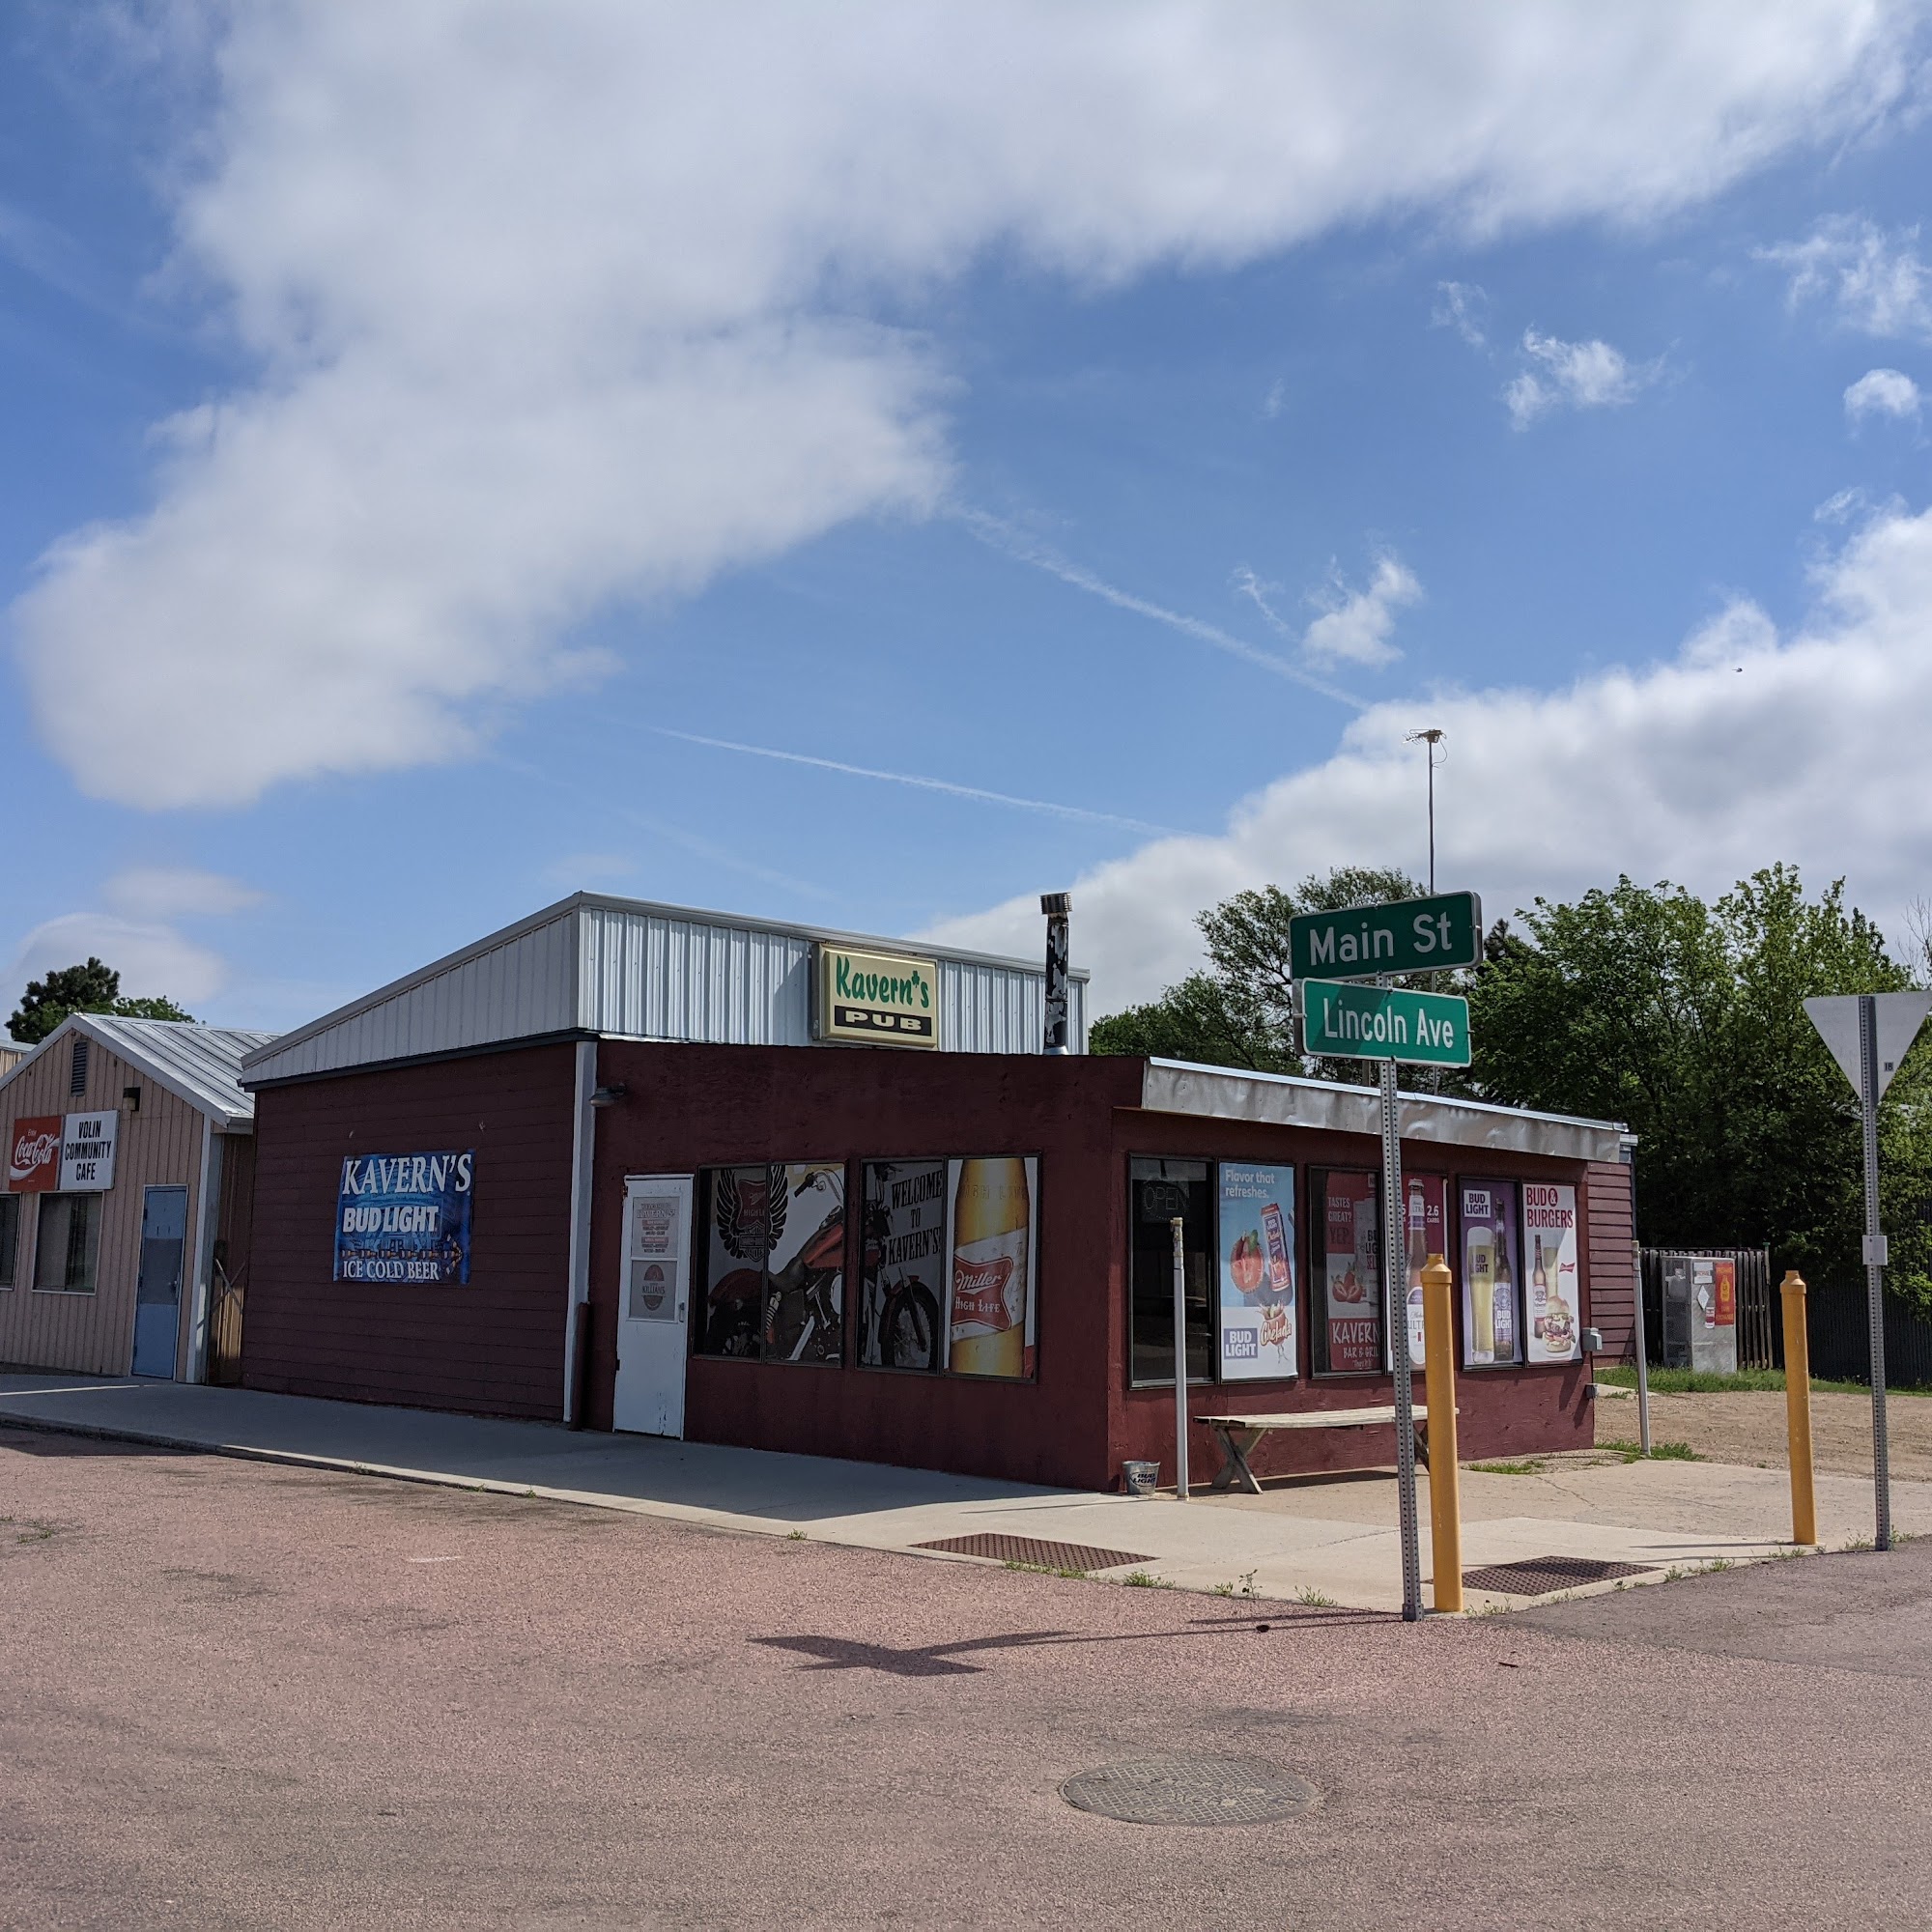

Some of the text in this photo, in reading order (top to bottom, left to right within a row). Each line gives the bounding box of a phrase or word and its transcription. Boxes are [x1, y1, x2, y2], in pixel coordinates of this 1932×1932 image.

[1309, 912, 1453, 966] Main St
[836, 954, 929, 1009] Kavern's
[845, 1010, 922, 1031] PUB
[1323, 998, 1454, 1048] Lincoln Ave
[78, 1121, 102, 1139] VOLIN
[65, 1141, 111, 1160] COMMUNITY
[76, 1162, 97, 1180] CAFE
[342, 1153, 471, 1195] KAVERN'S
[1225, 1169, 1274, 1184] Flavor that
[892, 1170, 943, 1209] WELCOME
[1144, 1186, 1189, 1210] OPEN
[1225, 1184, 1269, 1198] refreshes.
[1468, 1193, 1486, 1204] BUD
[1526, 1187, 1547, 1206] BUD
[1327, 1197, 1350, 1208] TASTES
[1427, 1205, 1439, 1216] 2.6
[1465, 1203, 1489, 1215] LIGHT
[343, 1207, 439, 1233] BUD LIGHT
[910, 1208, 921, 1229] TO
[1327, 1210, 1351, 1222] GREAT?
[1527, 1208, 1574, 1228] BURGERS
[343, 1261, 440, 1280] ICE COLD BEER
[955, 1269, 1002, 1291] Miller
[955, 1296, 1000, 1313] HIGH LIFE
[1229, 1330, 1252, 1344] BUD
[1260, 1318, 1293, 1346] Chelada
[1225, 1344, 1256, 1357] LIGHT
[1343, 1347, 1358, 1359] BAR
